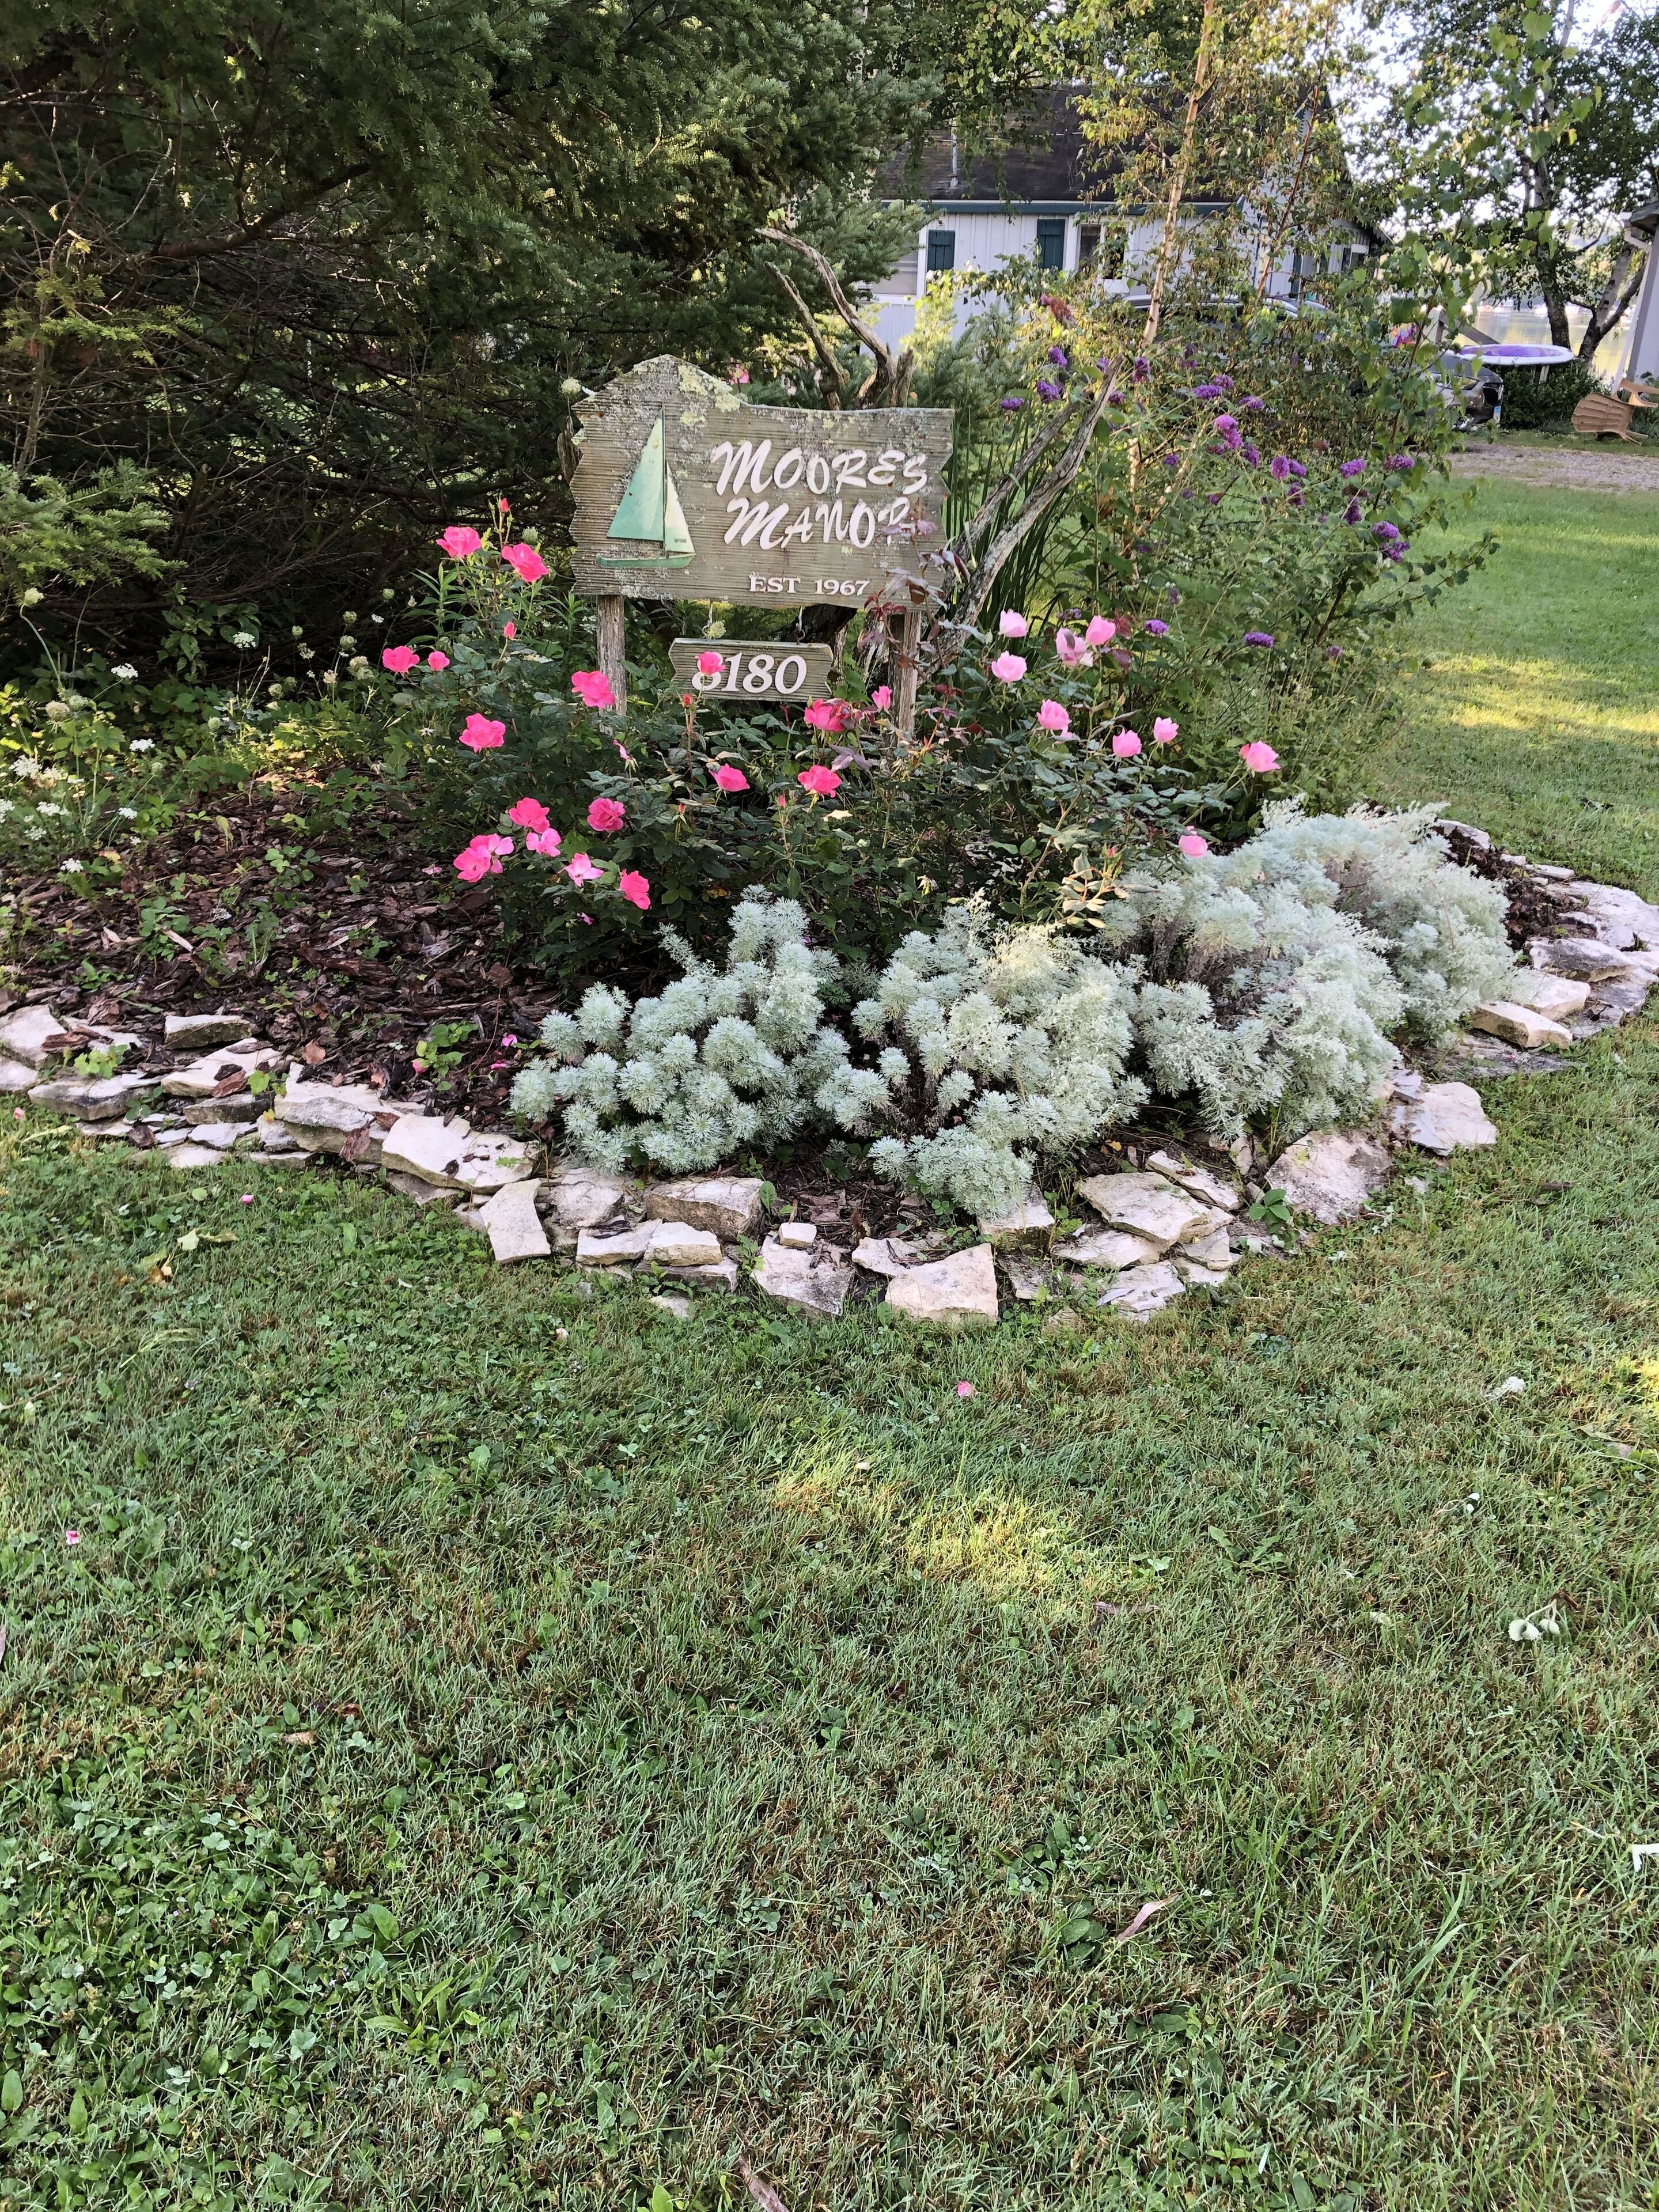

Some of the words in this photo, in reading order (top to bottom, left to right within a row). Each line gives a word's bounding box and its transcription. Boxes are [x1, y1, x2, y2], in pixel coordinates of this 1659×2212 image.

[710, 438, 928, 496] MOORES
[749, 575, 801, 594] EST
[814, 578, 871, 596] 1967
